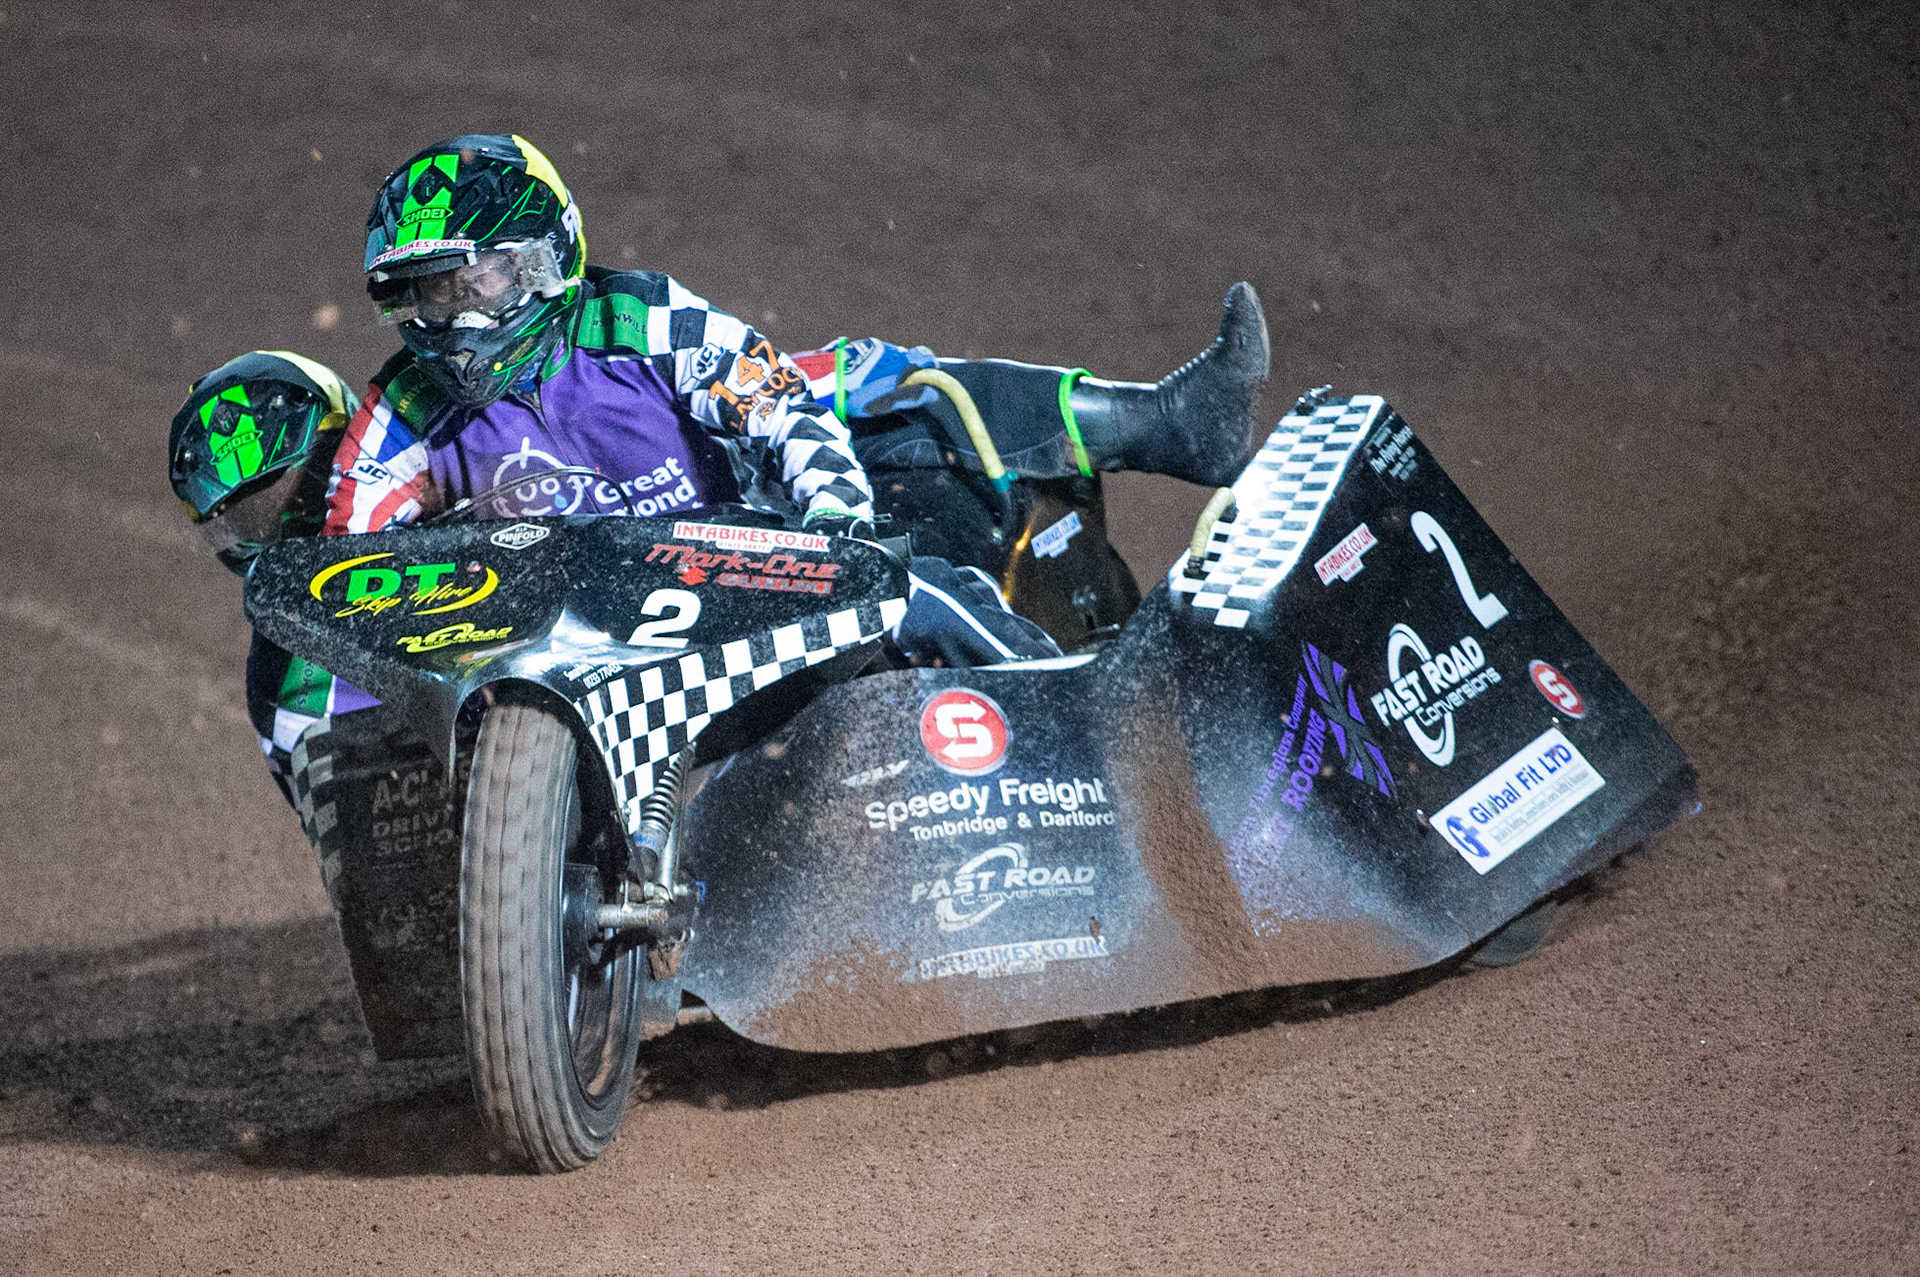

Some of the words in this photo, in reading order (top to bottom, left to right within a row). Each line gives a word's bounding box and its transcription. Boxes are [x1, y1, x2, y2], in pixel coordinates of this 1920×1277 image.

[403, 208, 445, 226] SHOEI
[709, 340, 780, 406] 147
[357, 464, 388, 480] JC
[594, 457, 683, 504] Great
[498, 530, 545, 543] PINFOLD
[676, 524, 827, 549] INTABIKES.CO.UK
[346, 562, 456, 602] DT
[644, 543, 842, 579] Mark-One
[1410, 510, 1510, 630] 2
[335, 594, 402, 617] Skip
[409, 582, 473, 608] Hire
[627, 588, 701, 648] 2
[1370, 669, 1428, 728] FAST
[1420, 635, 1486, 696] ROAD
[1415, 666, 1502, 727] Conversions
[1281, 707, 1327, 813] ROOFING
[864, 781, 990, 831] Speedy
[999, 777, 1108, 811] Freight
[1469, 781, 1522, 825] Global
[1516, 765, 1545, 792] Fit
[1537, 743, 1573, 775] LTD
[909, 813, 1008, 842] Tonbridge
[1017, 811, 1033, 829] &
[1040, 810, 1116, 828] Dartford
[910, 870, 997, 904] FAST
[1003, 866, 1096, 889] ROAD
